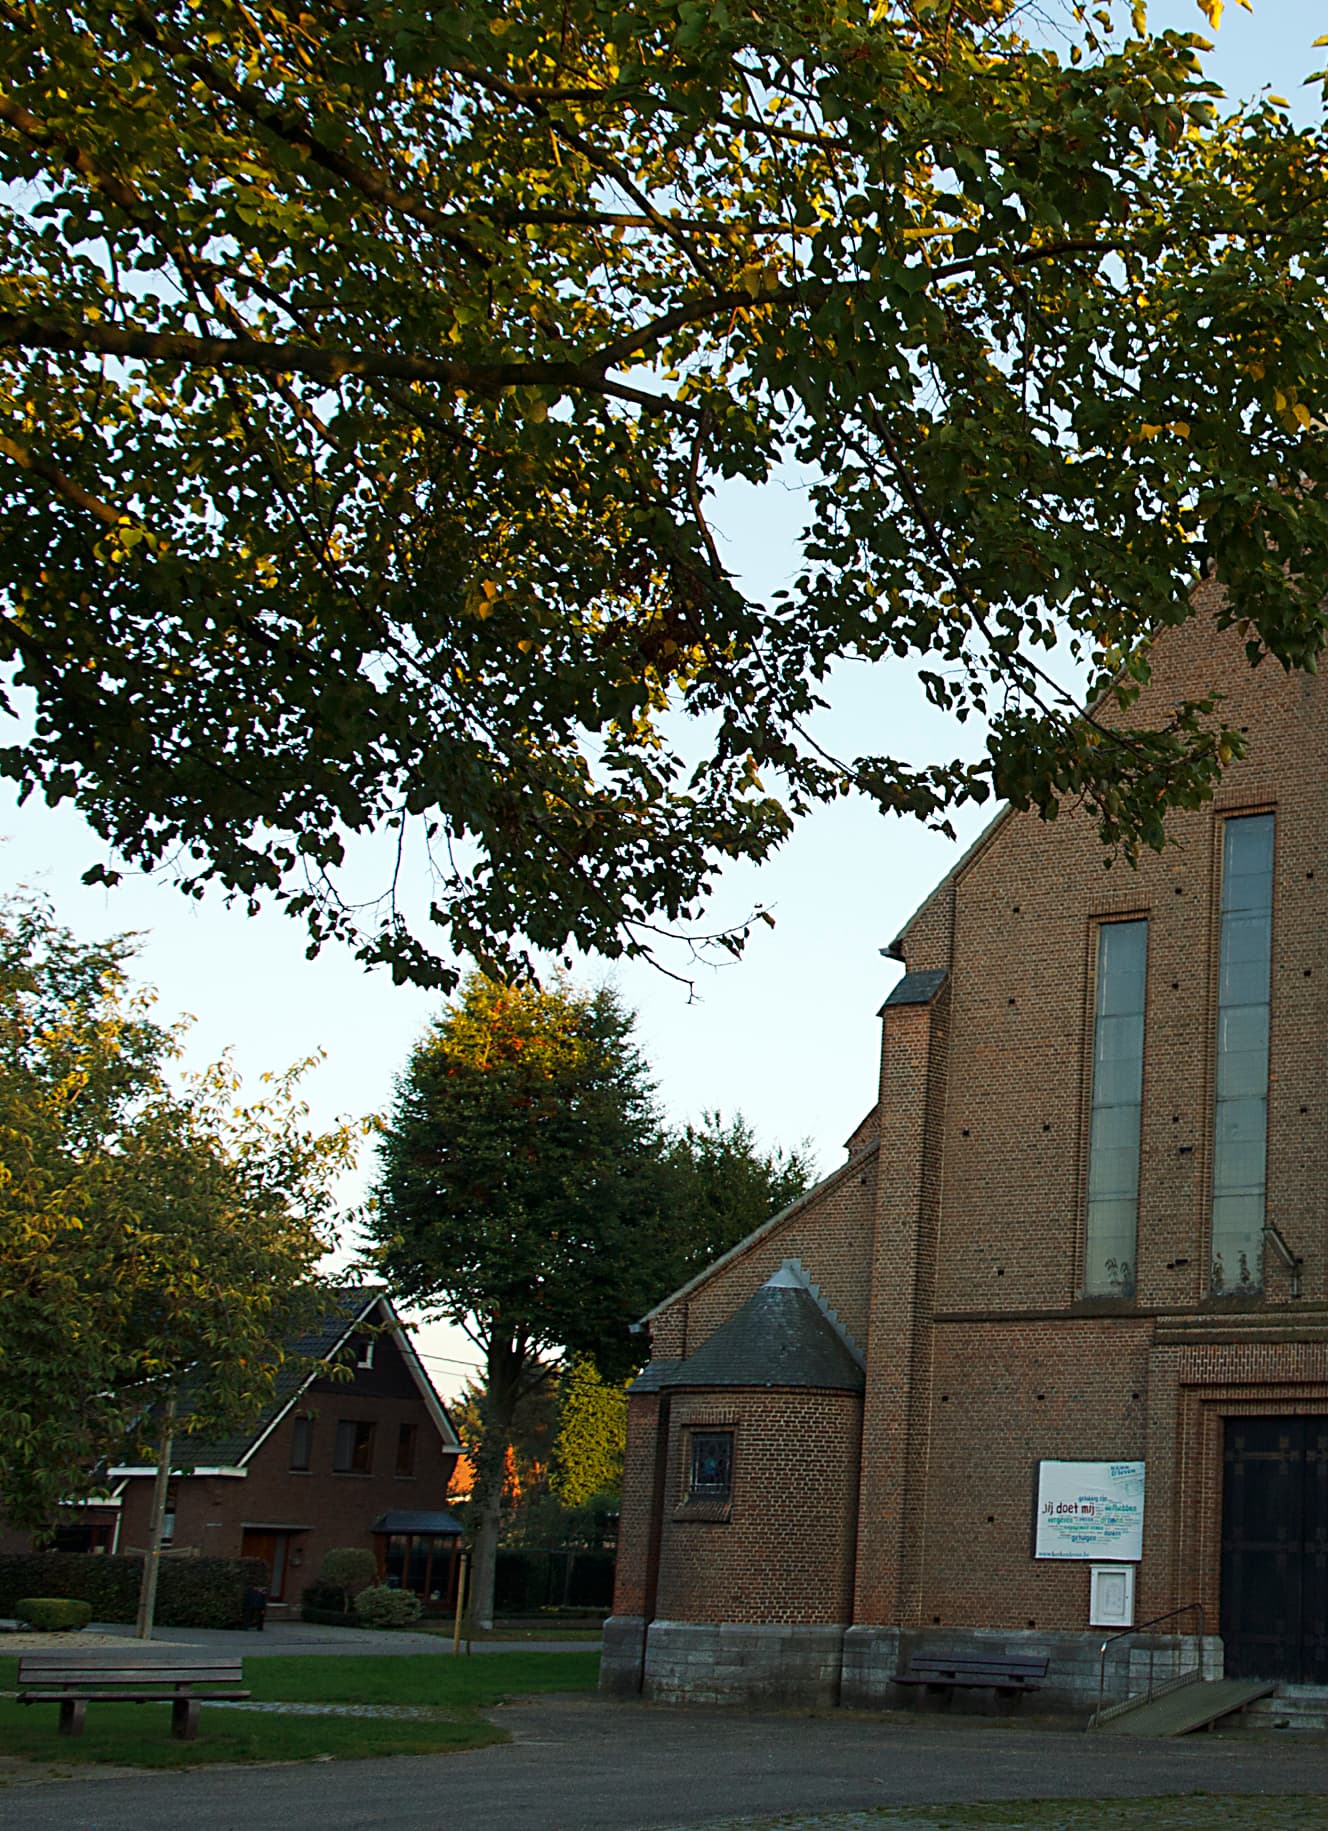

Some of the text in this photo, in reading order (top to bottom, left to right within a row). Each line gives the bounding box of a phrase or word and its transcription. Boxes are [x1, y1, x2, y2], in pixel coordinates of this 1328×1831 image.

[1042, 1501, 1054, 1516] Jij
[1056, 1501, 1078, 1514] doet
[1081, 1502, 1095, 1516] mij
